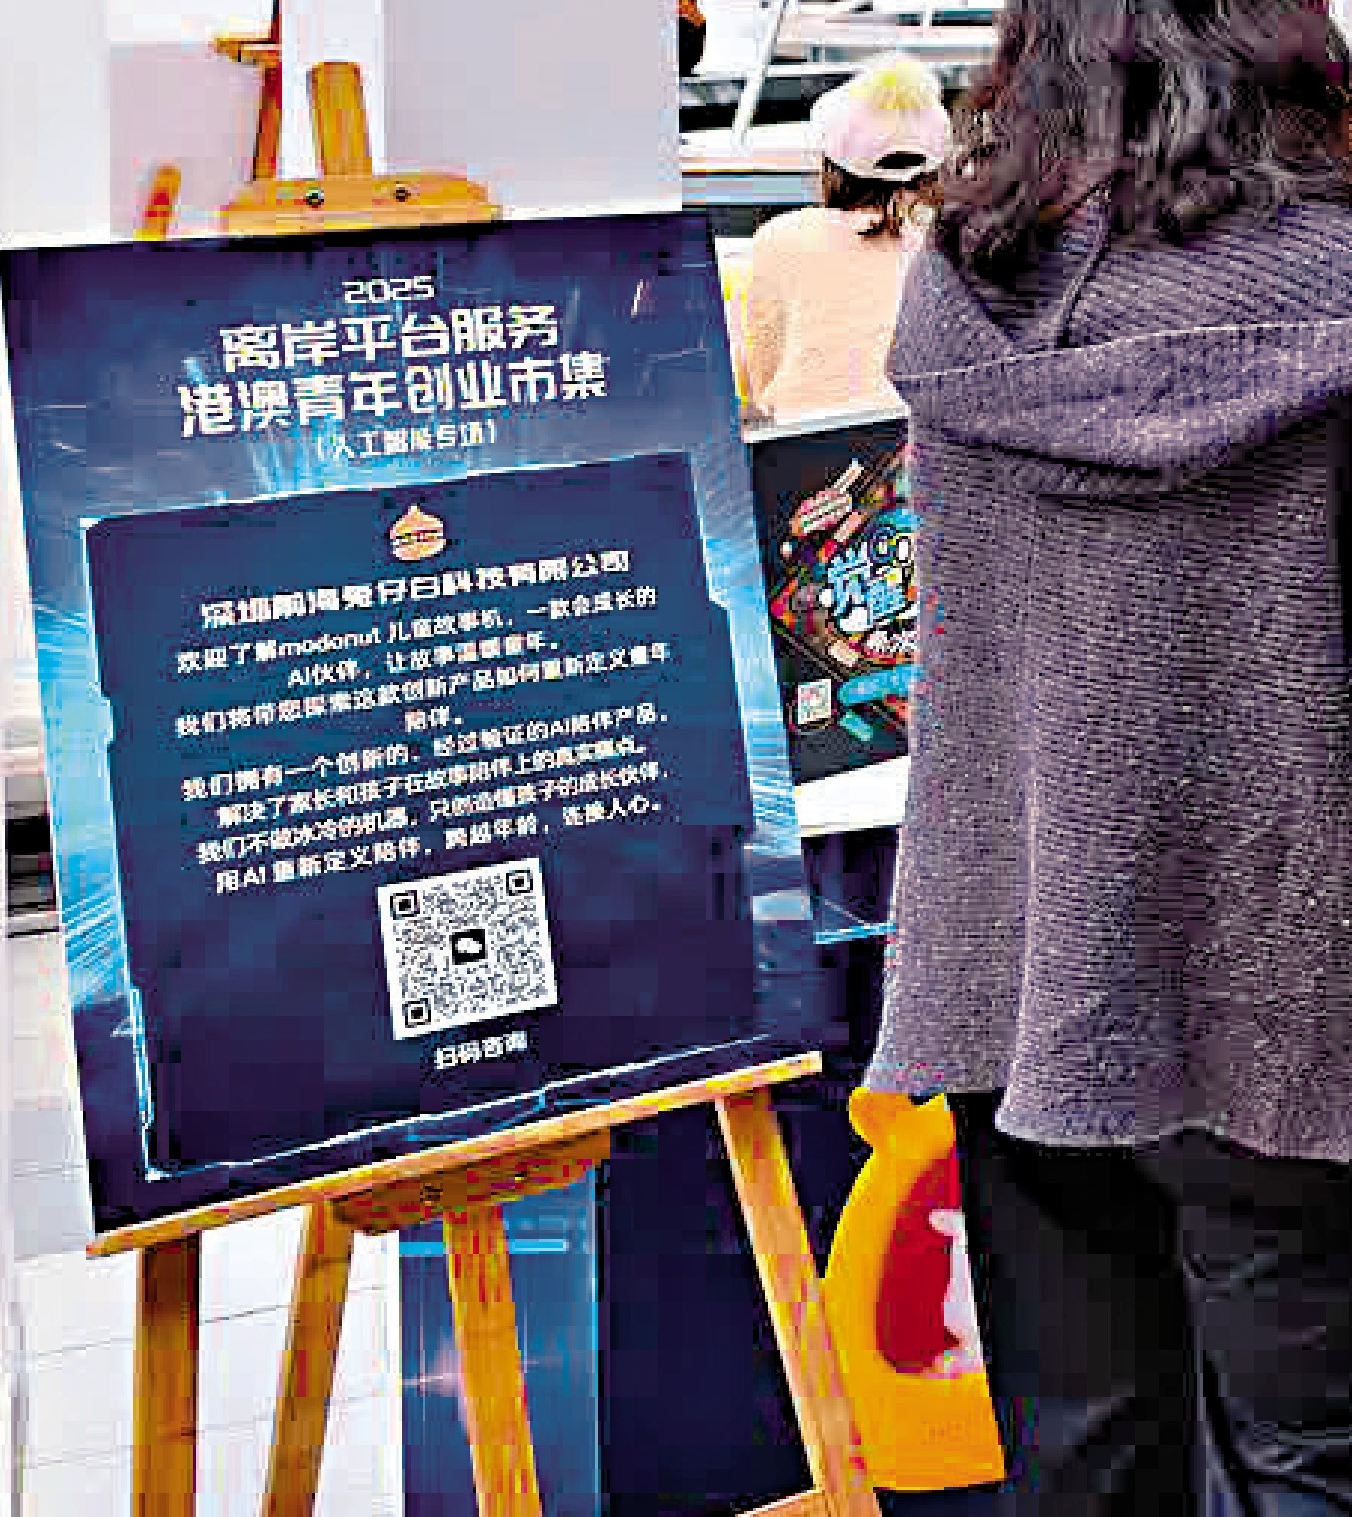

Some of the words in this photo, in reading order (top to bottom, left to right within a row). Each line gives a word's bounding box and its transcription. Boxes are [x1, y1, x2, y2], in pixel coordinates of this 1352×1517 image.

[342, 275, 436, 304] 2025
[219, 304, 559, 373] 离岸平台服务
[177, 350, 612, 438] 港澳青年创业市集
[200, 550, 630, 630] 深圳前海兔仔白科技有限公司
